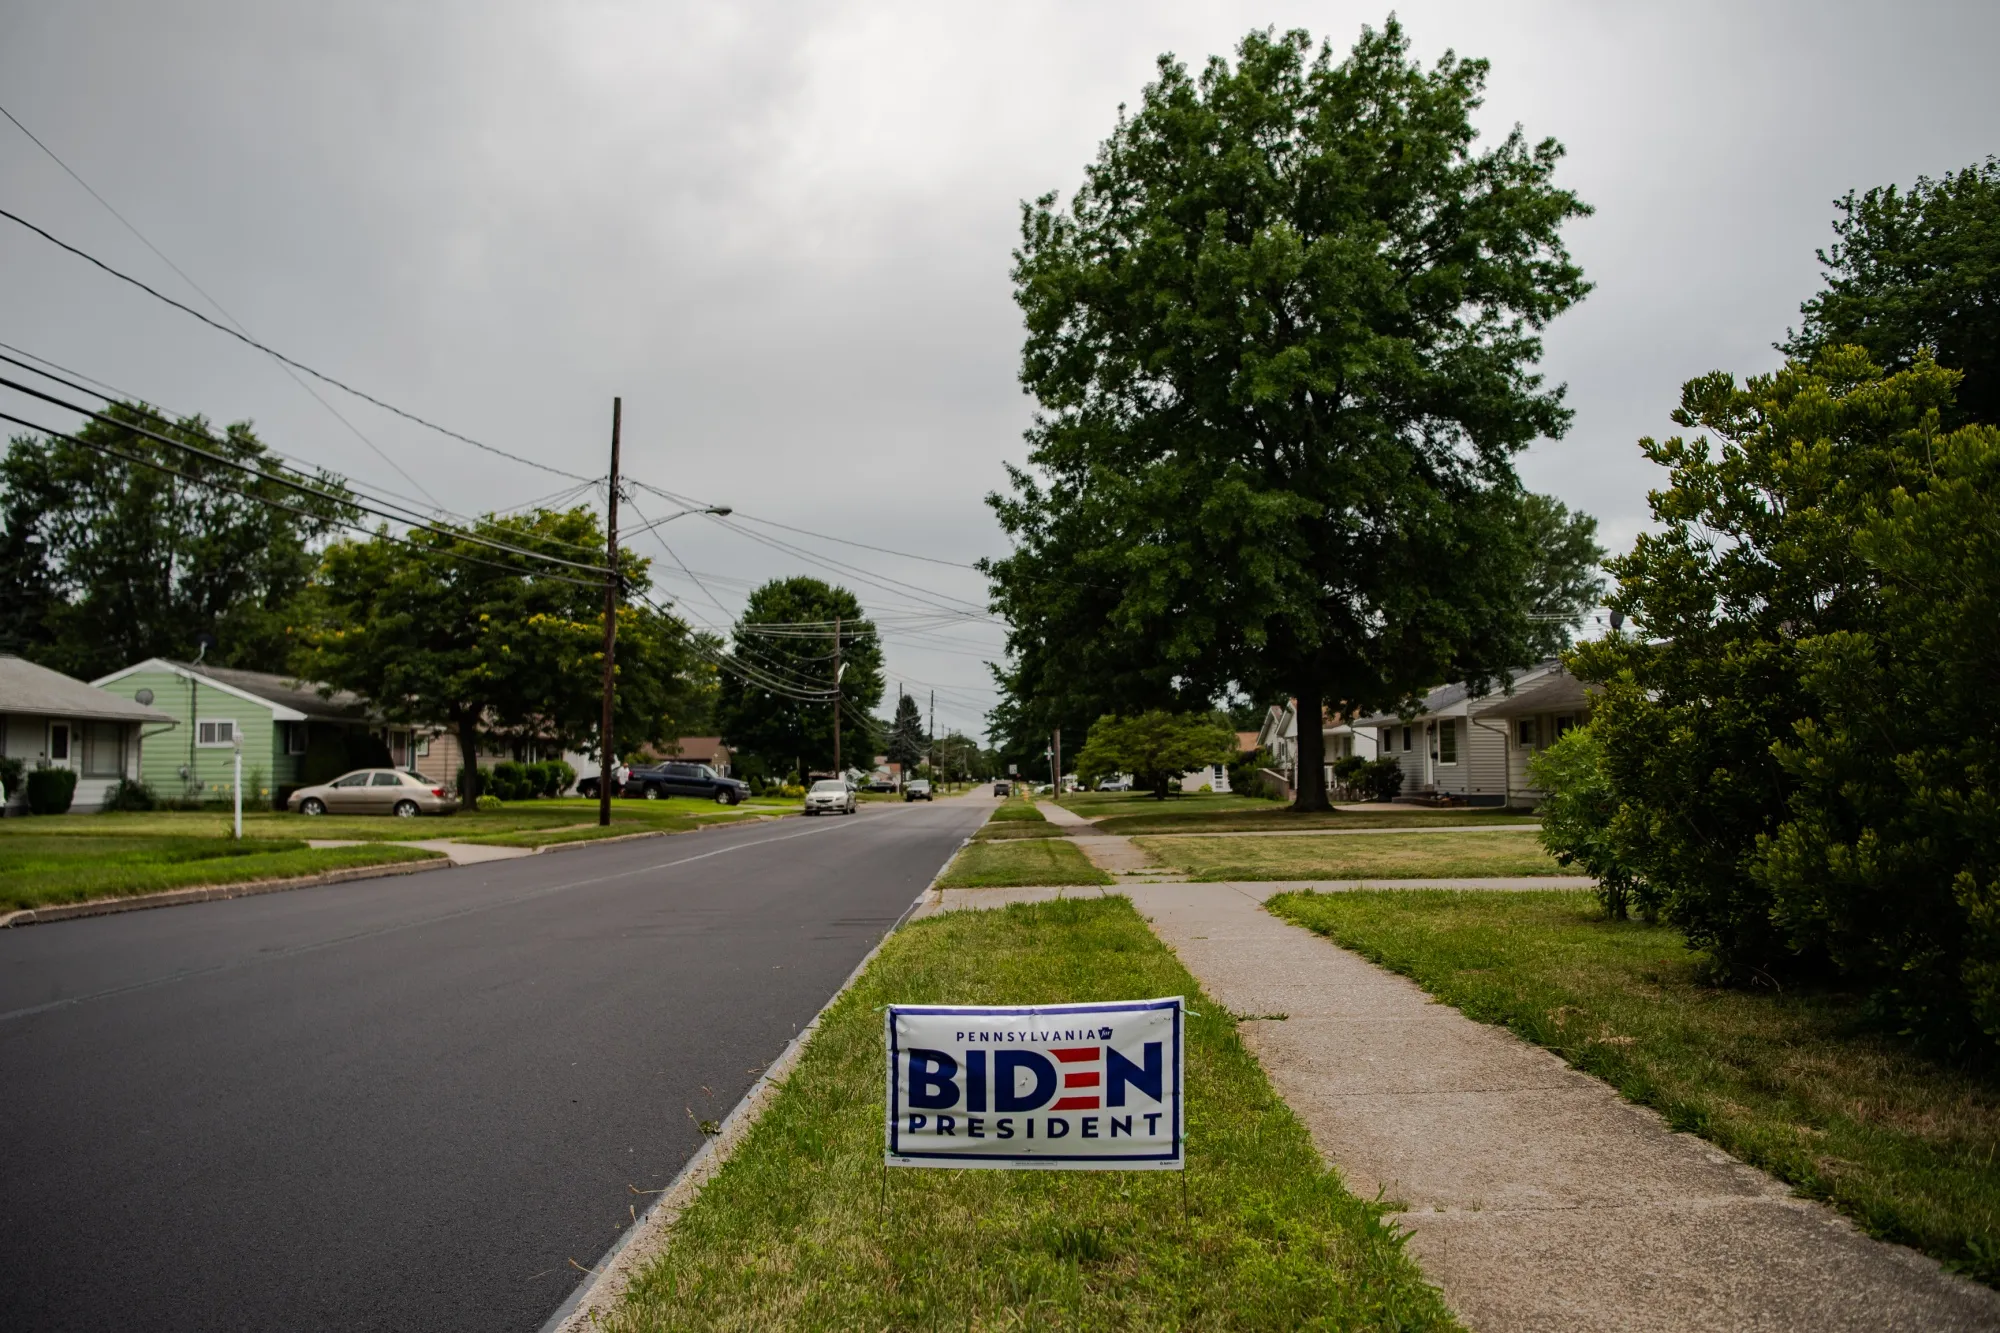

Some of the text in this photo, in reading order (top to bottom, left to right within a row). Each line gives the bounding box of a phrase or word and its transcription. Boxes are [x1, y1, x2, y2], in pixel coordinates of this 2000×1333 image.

[957, 1030, 1095, 1041] PENNSYLVANIA
[908, 1041, 1162, 1112] BIDEN
[909, 1113, 1162, 1138] PRESIDENT
